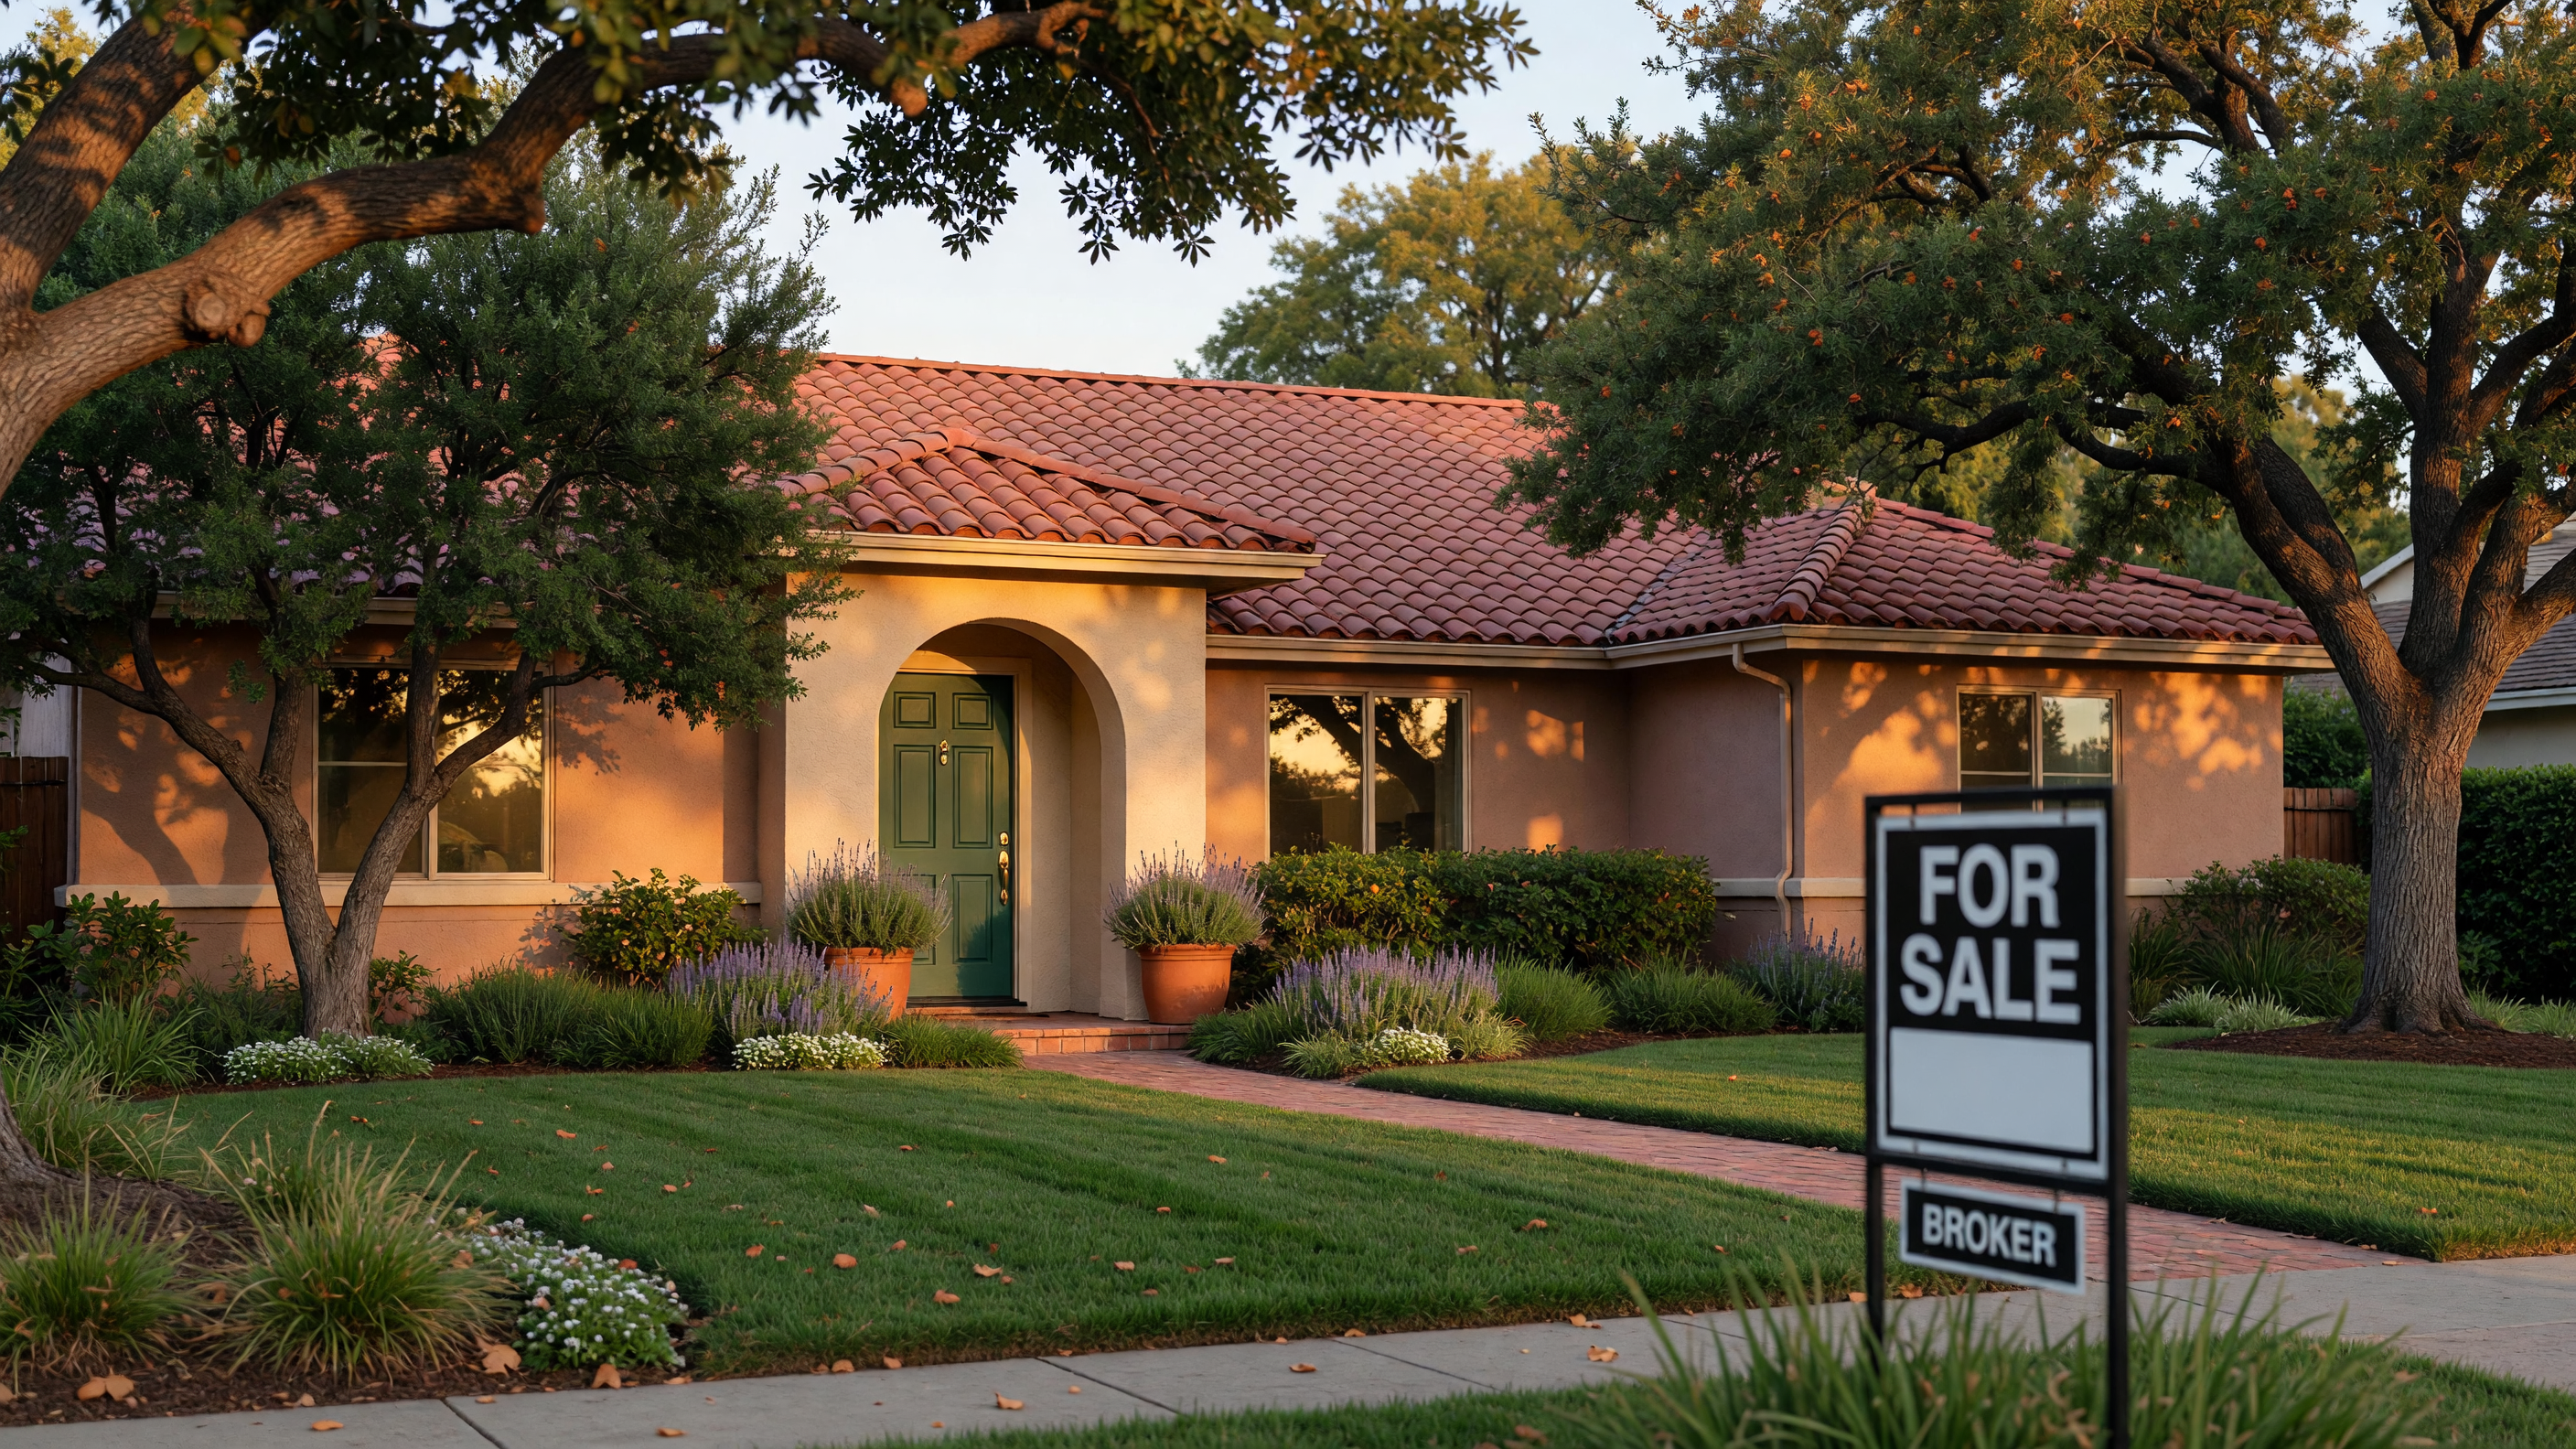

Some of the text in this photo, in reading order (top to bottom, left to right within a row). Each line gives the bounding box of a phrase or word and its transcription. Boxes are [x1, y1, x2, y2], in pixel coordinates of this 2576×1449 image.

[1920, 843, 2060, 928] FOR
[1900, 933, 2081, 1025] SALE
[1922, 1203, 2056, 1267] BROKER
